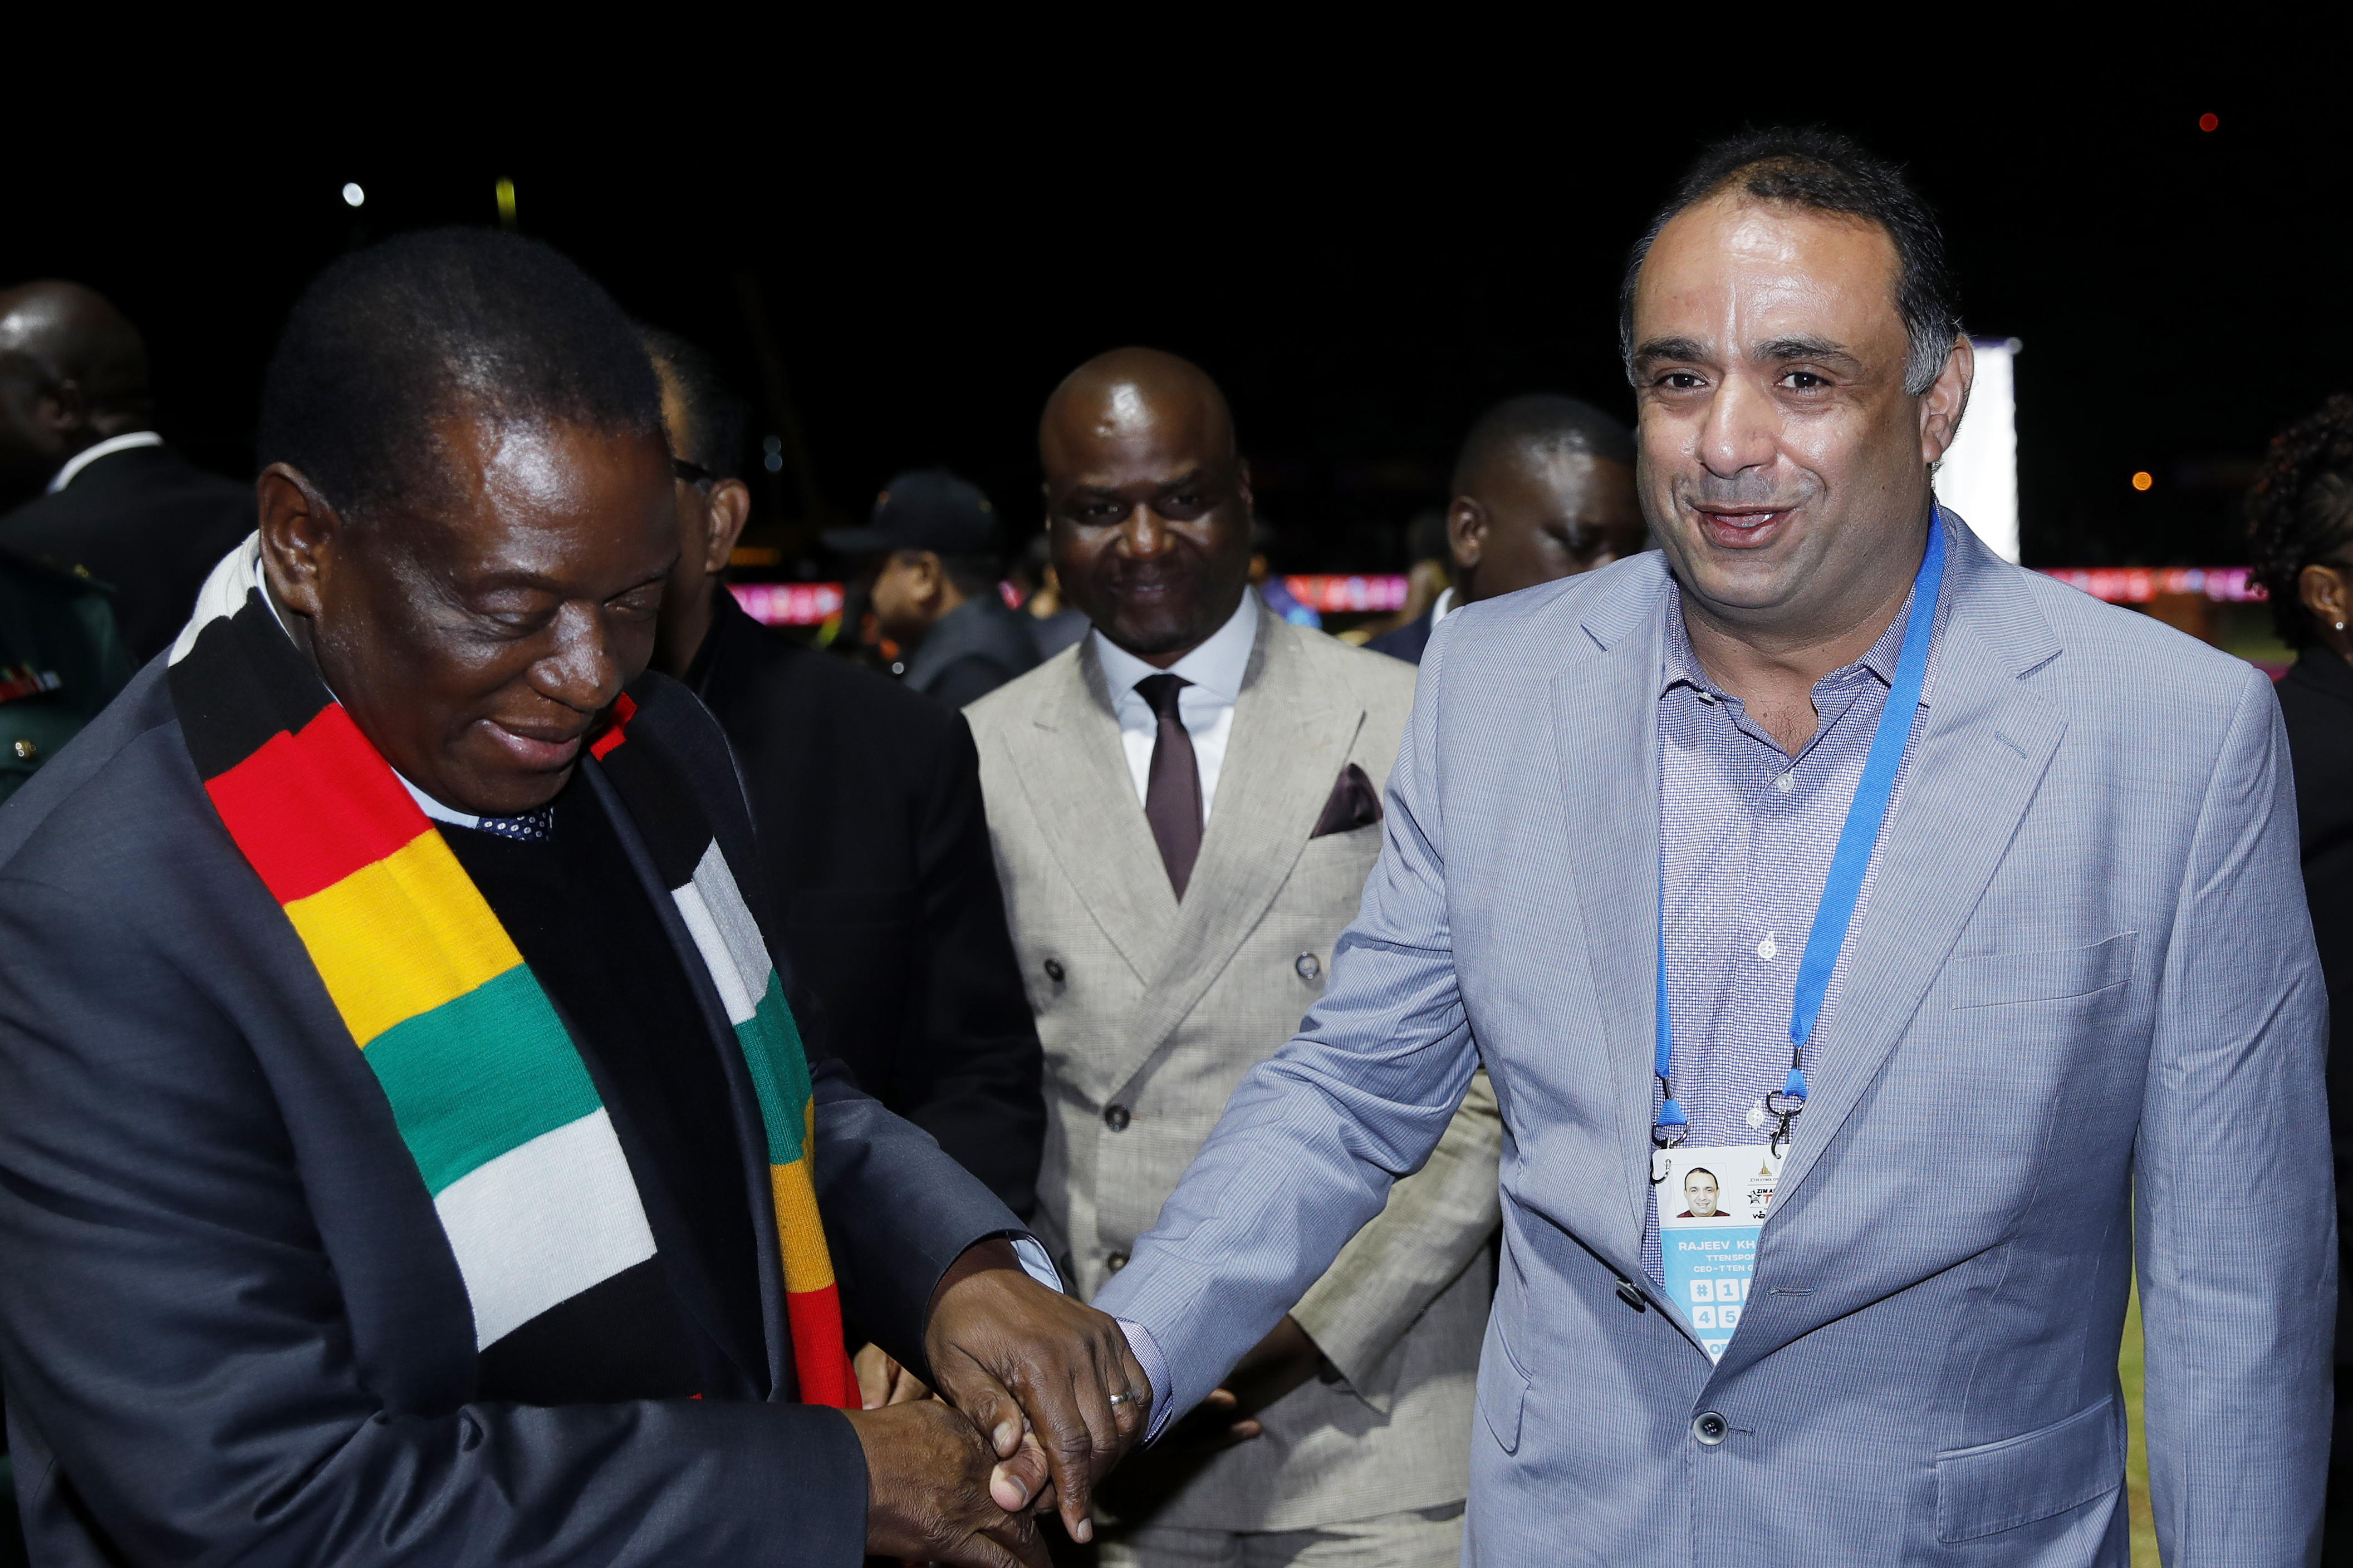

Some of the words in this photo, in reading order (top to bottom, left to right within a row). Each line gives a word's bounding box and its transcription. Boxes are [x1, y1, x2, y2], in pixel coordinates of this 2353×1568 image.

[1763, 1194, 1773, 1204] T
[1678, 1241, 1730, 1251] RAJEEV
[1737, 1240, 1756, 1250] KH
[1698, 1311, 1710, 1324] 4
[1725, 1310, 1736, 1323] 5
